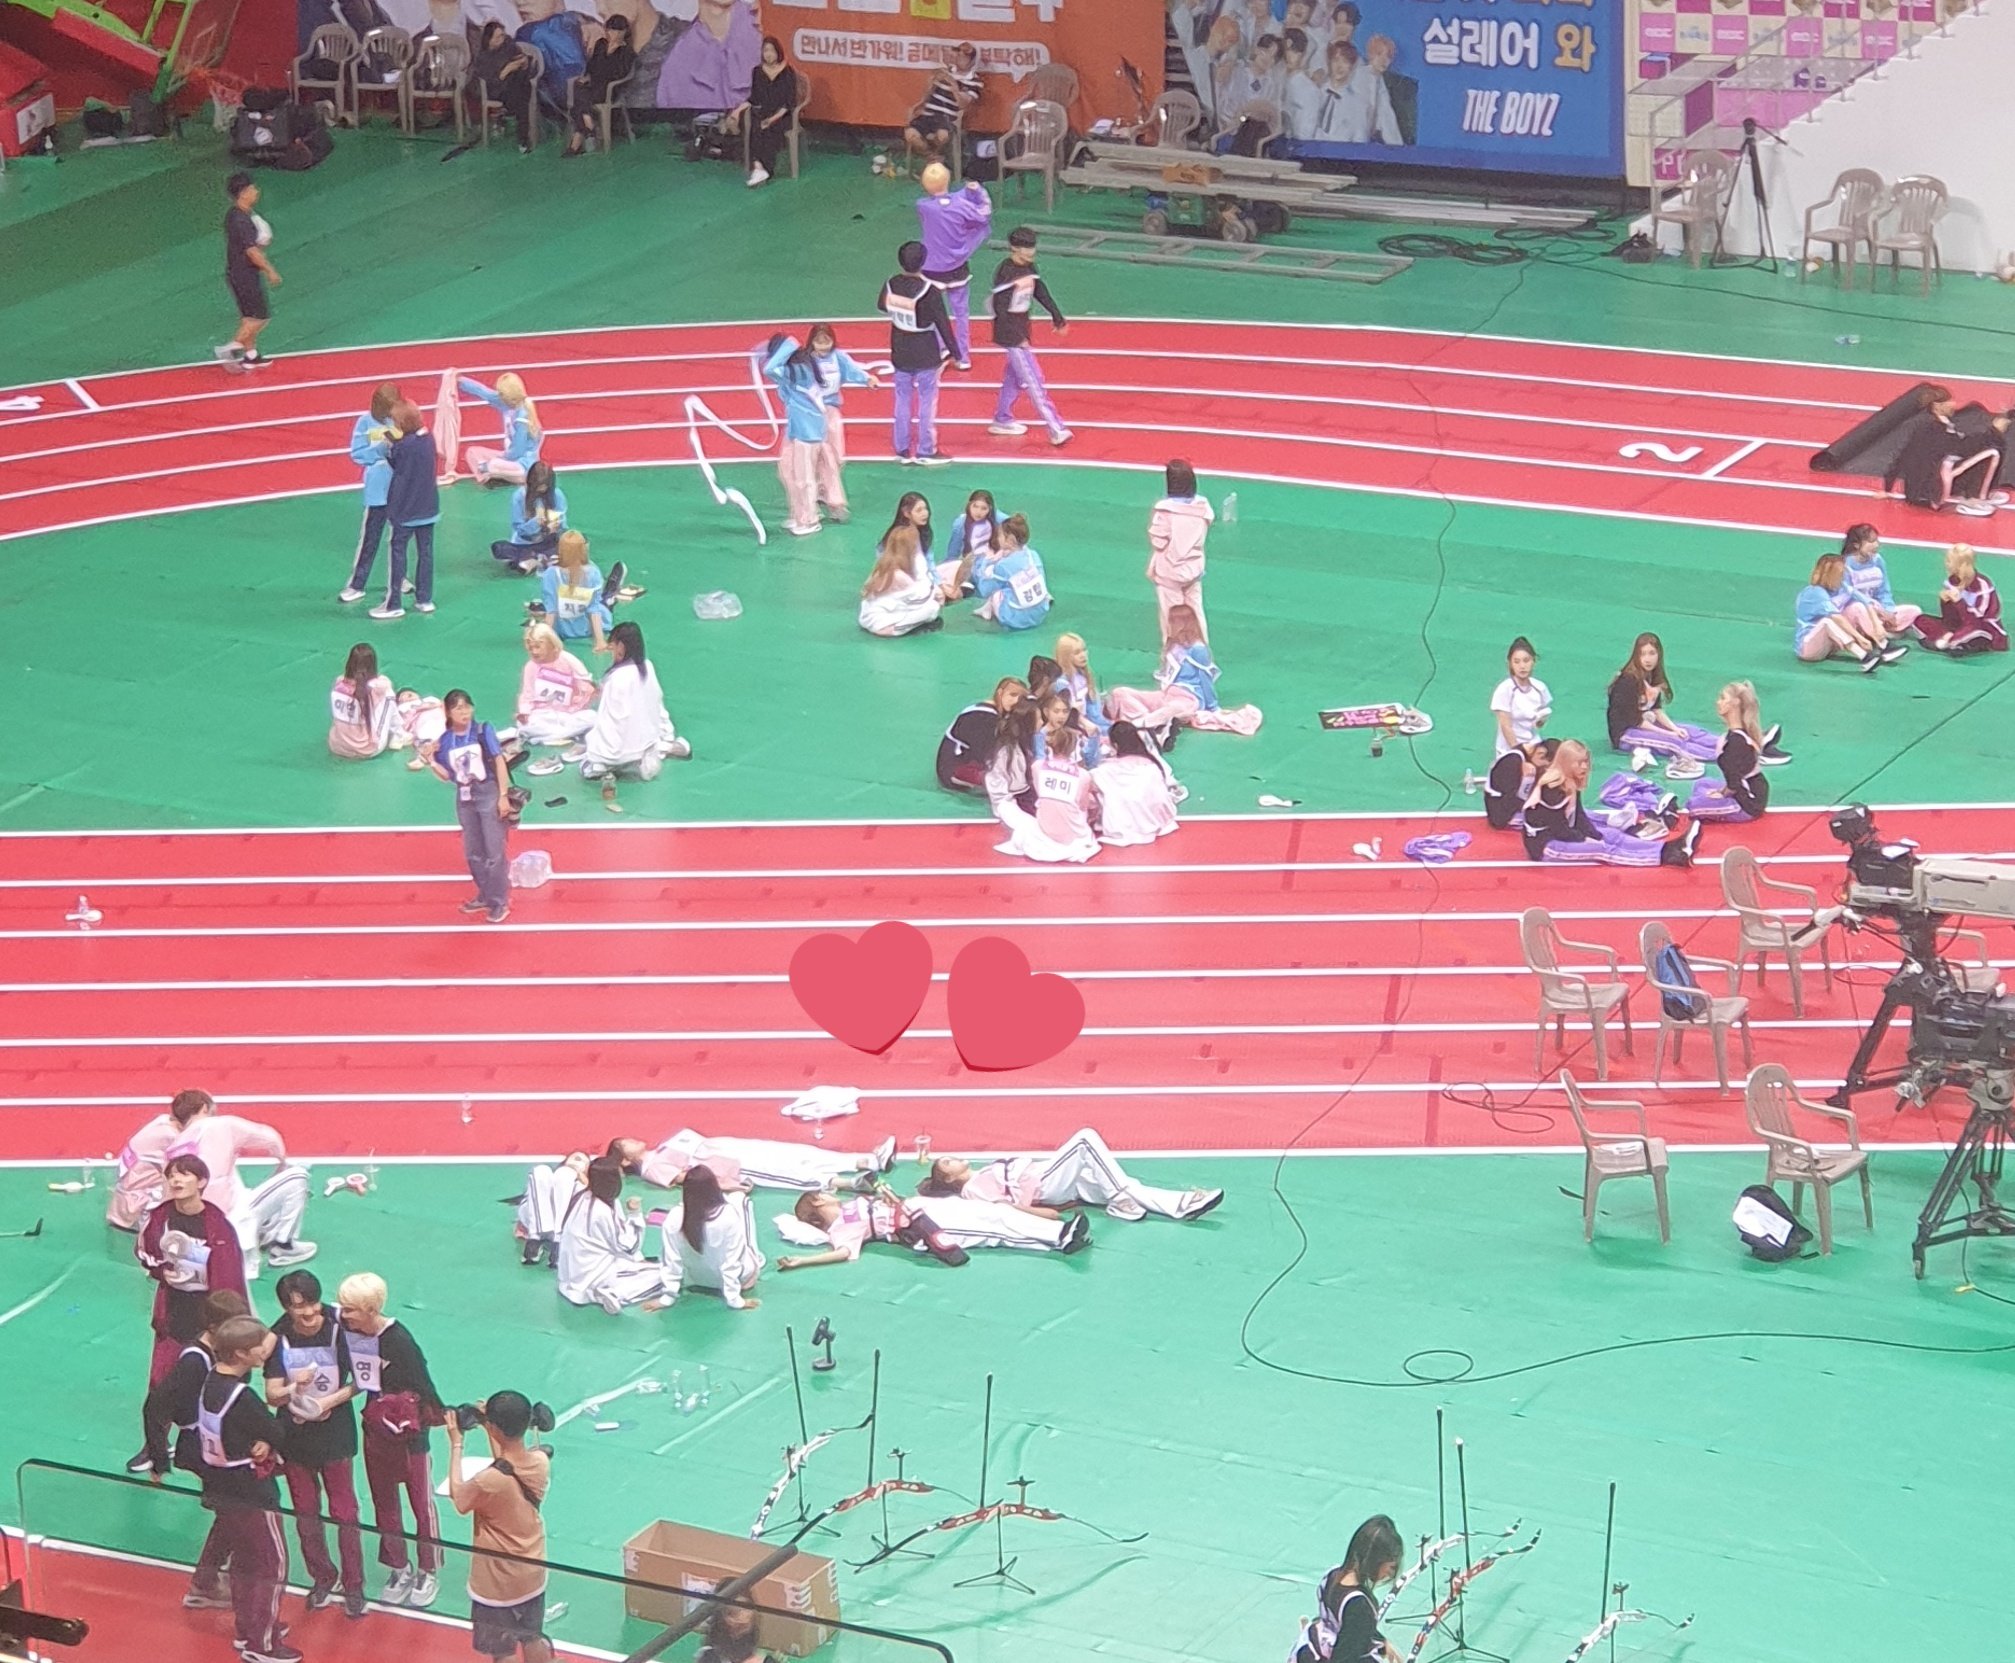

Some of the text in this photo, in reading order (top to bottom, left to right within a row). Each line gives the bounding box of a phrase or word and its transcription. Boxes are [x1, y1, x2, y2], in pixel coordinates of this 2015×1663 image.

[801, 34, 848, 57] 만나서
[906, 42, 956, 63] 금메
[1423, 16, 1597, 73] 설레어 와
[1462, 88, 1562, 136] THE BOYZ
[1618, 441, 1704, 463] 2
[1044, 776, 1071, 795] 레미
